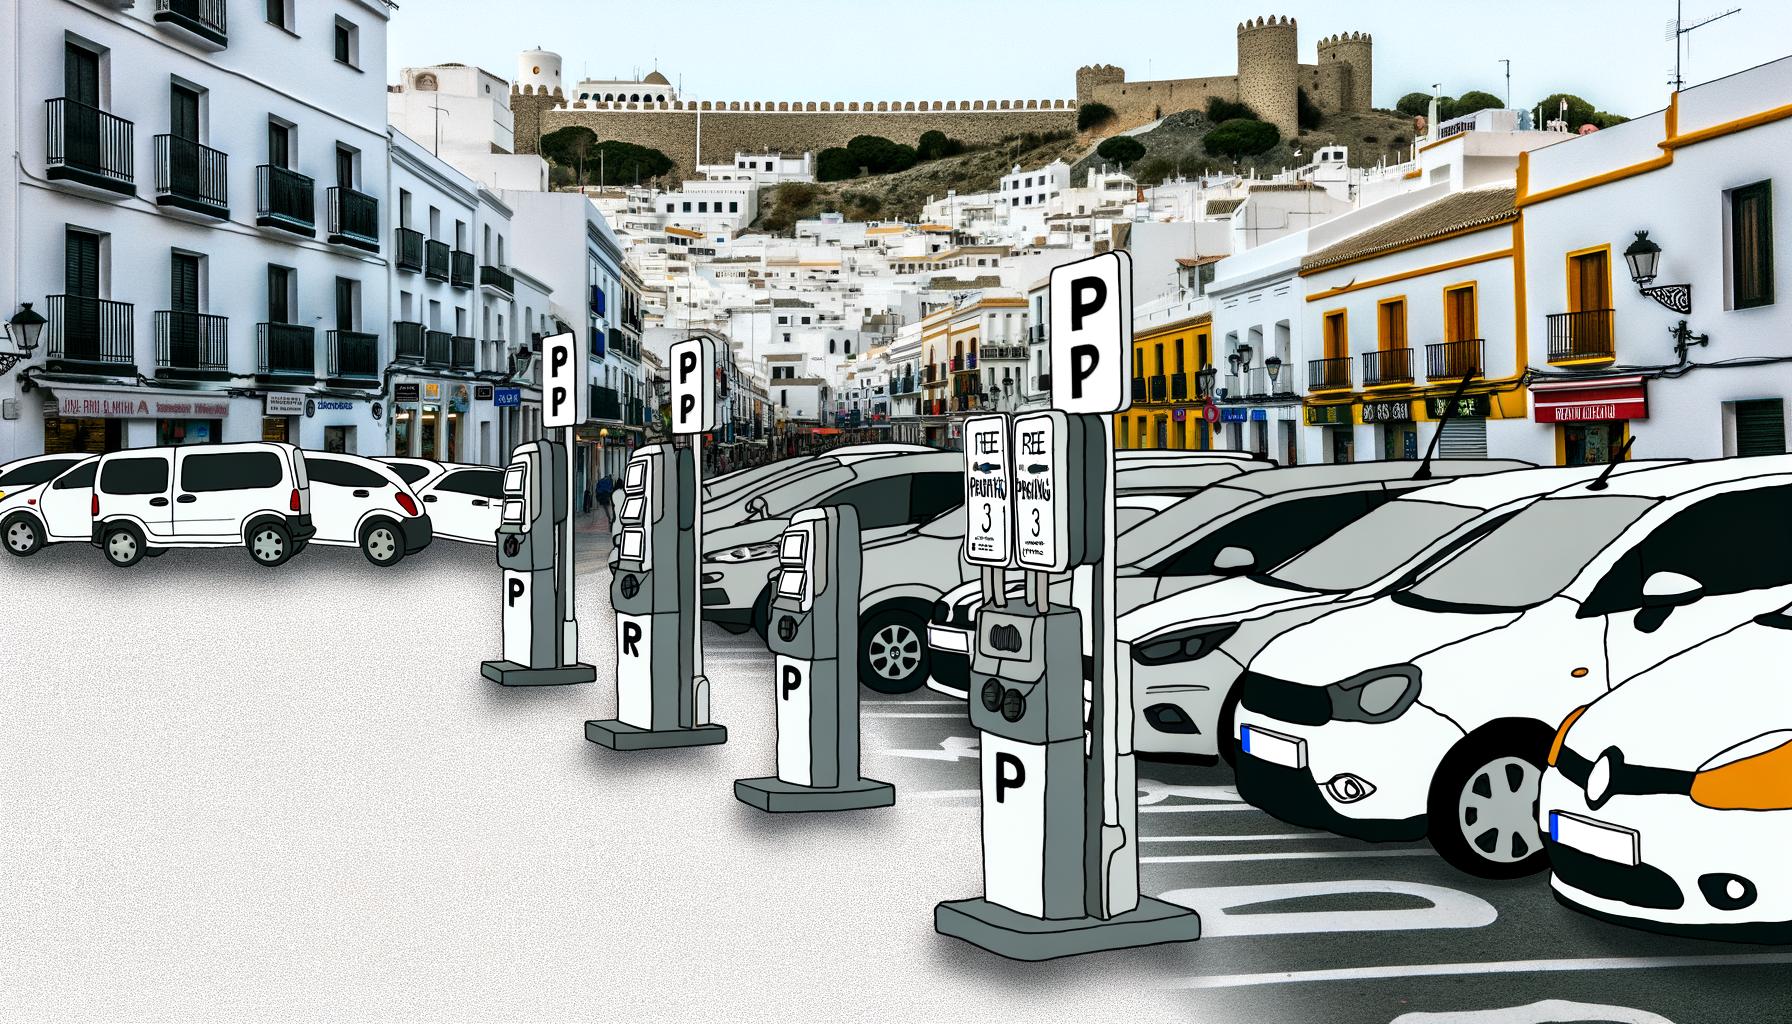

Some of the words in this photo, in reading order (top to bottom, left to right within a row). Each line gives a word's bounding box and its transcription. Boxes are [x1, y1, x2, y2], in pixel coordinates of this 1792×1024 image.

[1071, 276, 1107, 331] P
[552, 346, 567, 377] P
[680, 351, 696, 384] P
[1071, 344, 1099, 399] P
[553, 387, 566, 416] P
[681, 394, 695, 423] P
[981, 503, 992, 533] 3
[1031, 508, 1040, 537] 3
[509, 578, 524, 607] P
[624, 621, 641, 657] R
[783, 665, 801, 700] P
[996, 752, 1025, 803] P
